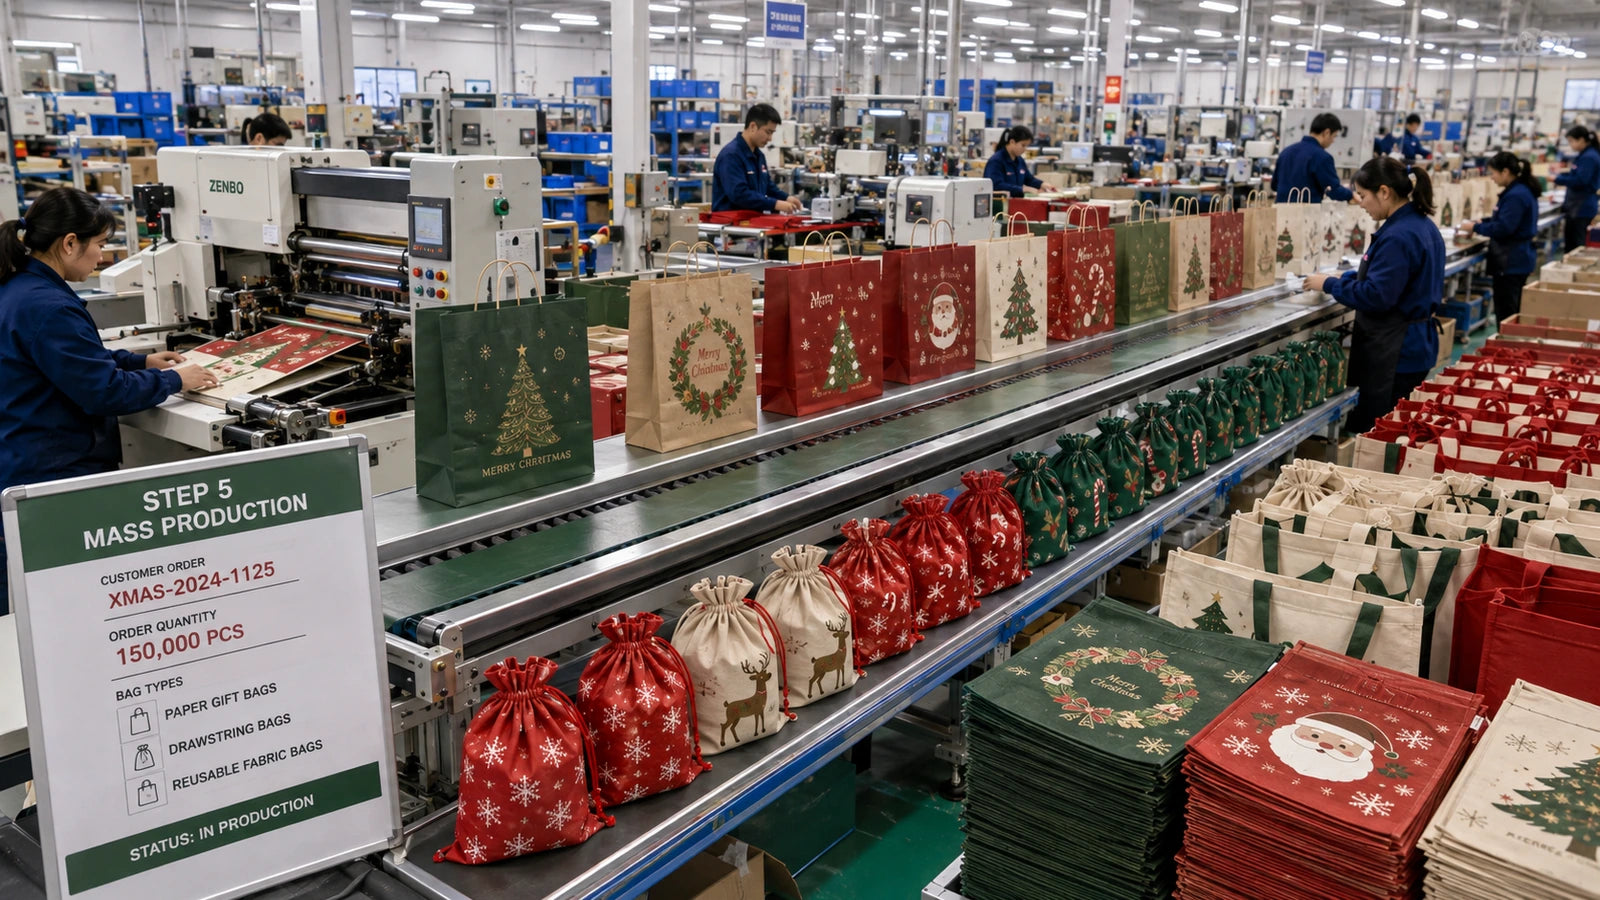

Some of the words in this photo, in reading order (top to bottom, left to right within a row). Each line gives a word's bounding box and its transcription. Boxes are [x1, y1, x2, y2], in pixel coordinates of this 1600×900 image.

[209, 179, 244, 195] ZENBO
[697, 347, 721, 361] Merry
[482, 462, 516, 478] MERRY
[143, 482, 209, 512] STEP
[218, 478, 233, 499] 5
[83, 520, 154, 550] MASS
[161, 492, 308, 536] PRODUCTION
[100, 565, 165, 586] CUSTOMER
[167, 557, 206, 573] ORDER
[108, 561, 275, 609] XMAS-2024-1125
[109, 624, 153, 642] ORDER
[156, 609, 217, 631] QUANTITY
[116, 631, 201, 665] 150,000
[207, 623, 245, 645] PCS
[115, 686, 142, 702] BAG
[145, 676, 184, 694] TYPES
[1104, 674, 1140, 691] Merry
[165, 699, 208, 720] PAPER
[211, 691, 240, 708] GIFT
[243, 682, 278, 700] BAGS
[168, 722, 254, 756] DRAWSTRING
[257, 713, 292, 731] BAGS
[172, 762, 240, 791] REUSABLE
[243, 749, 287, 771] FABRIC
[290, 739, 324, 758] BAGS
[130, 832, 195, 862] STATUS:
[199, 824, 215, 840] IN
[219, 793, 315, 834] PRODUCTION
